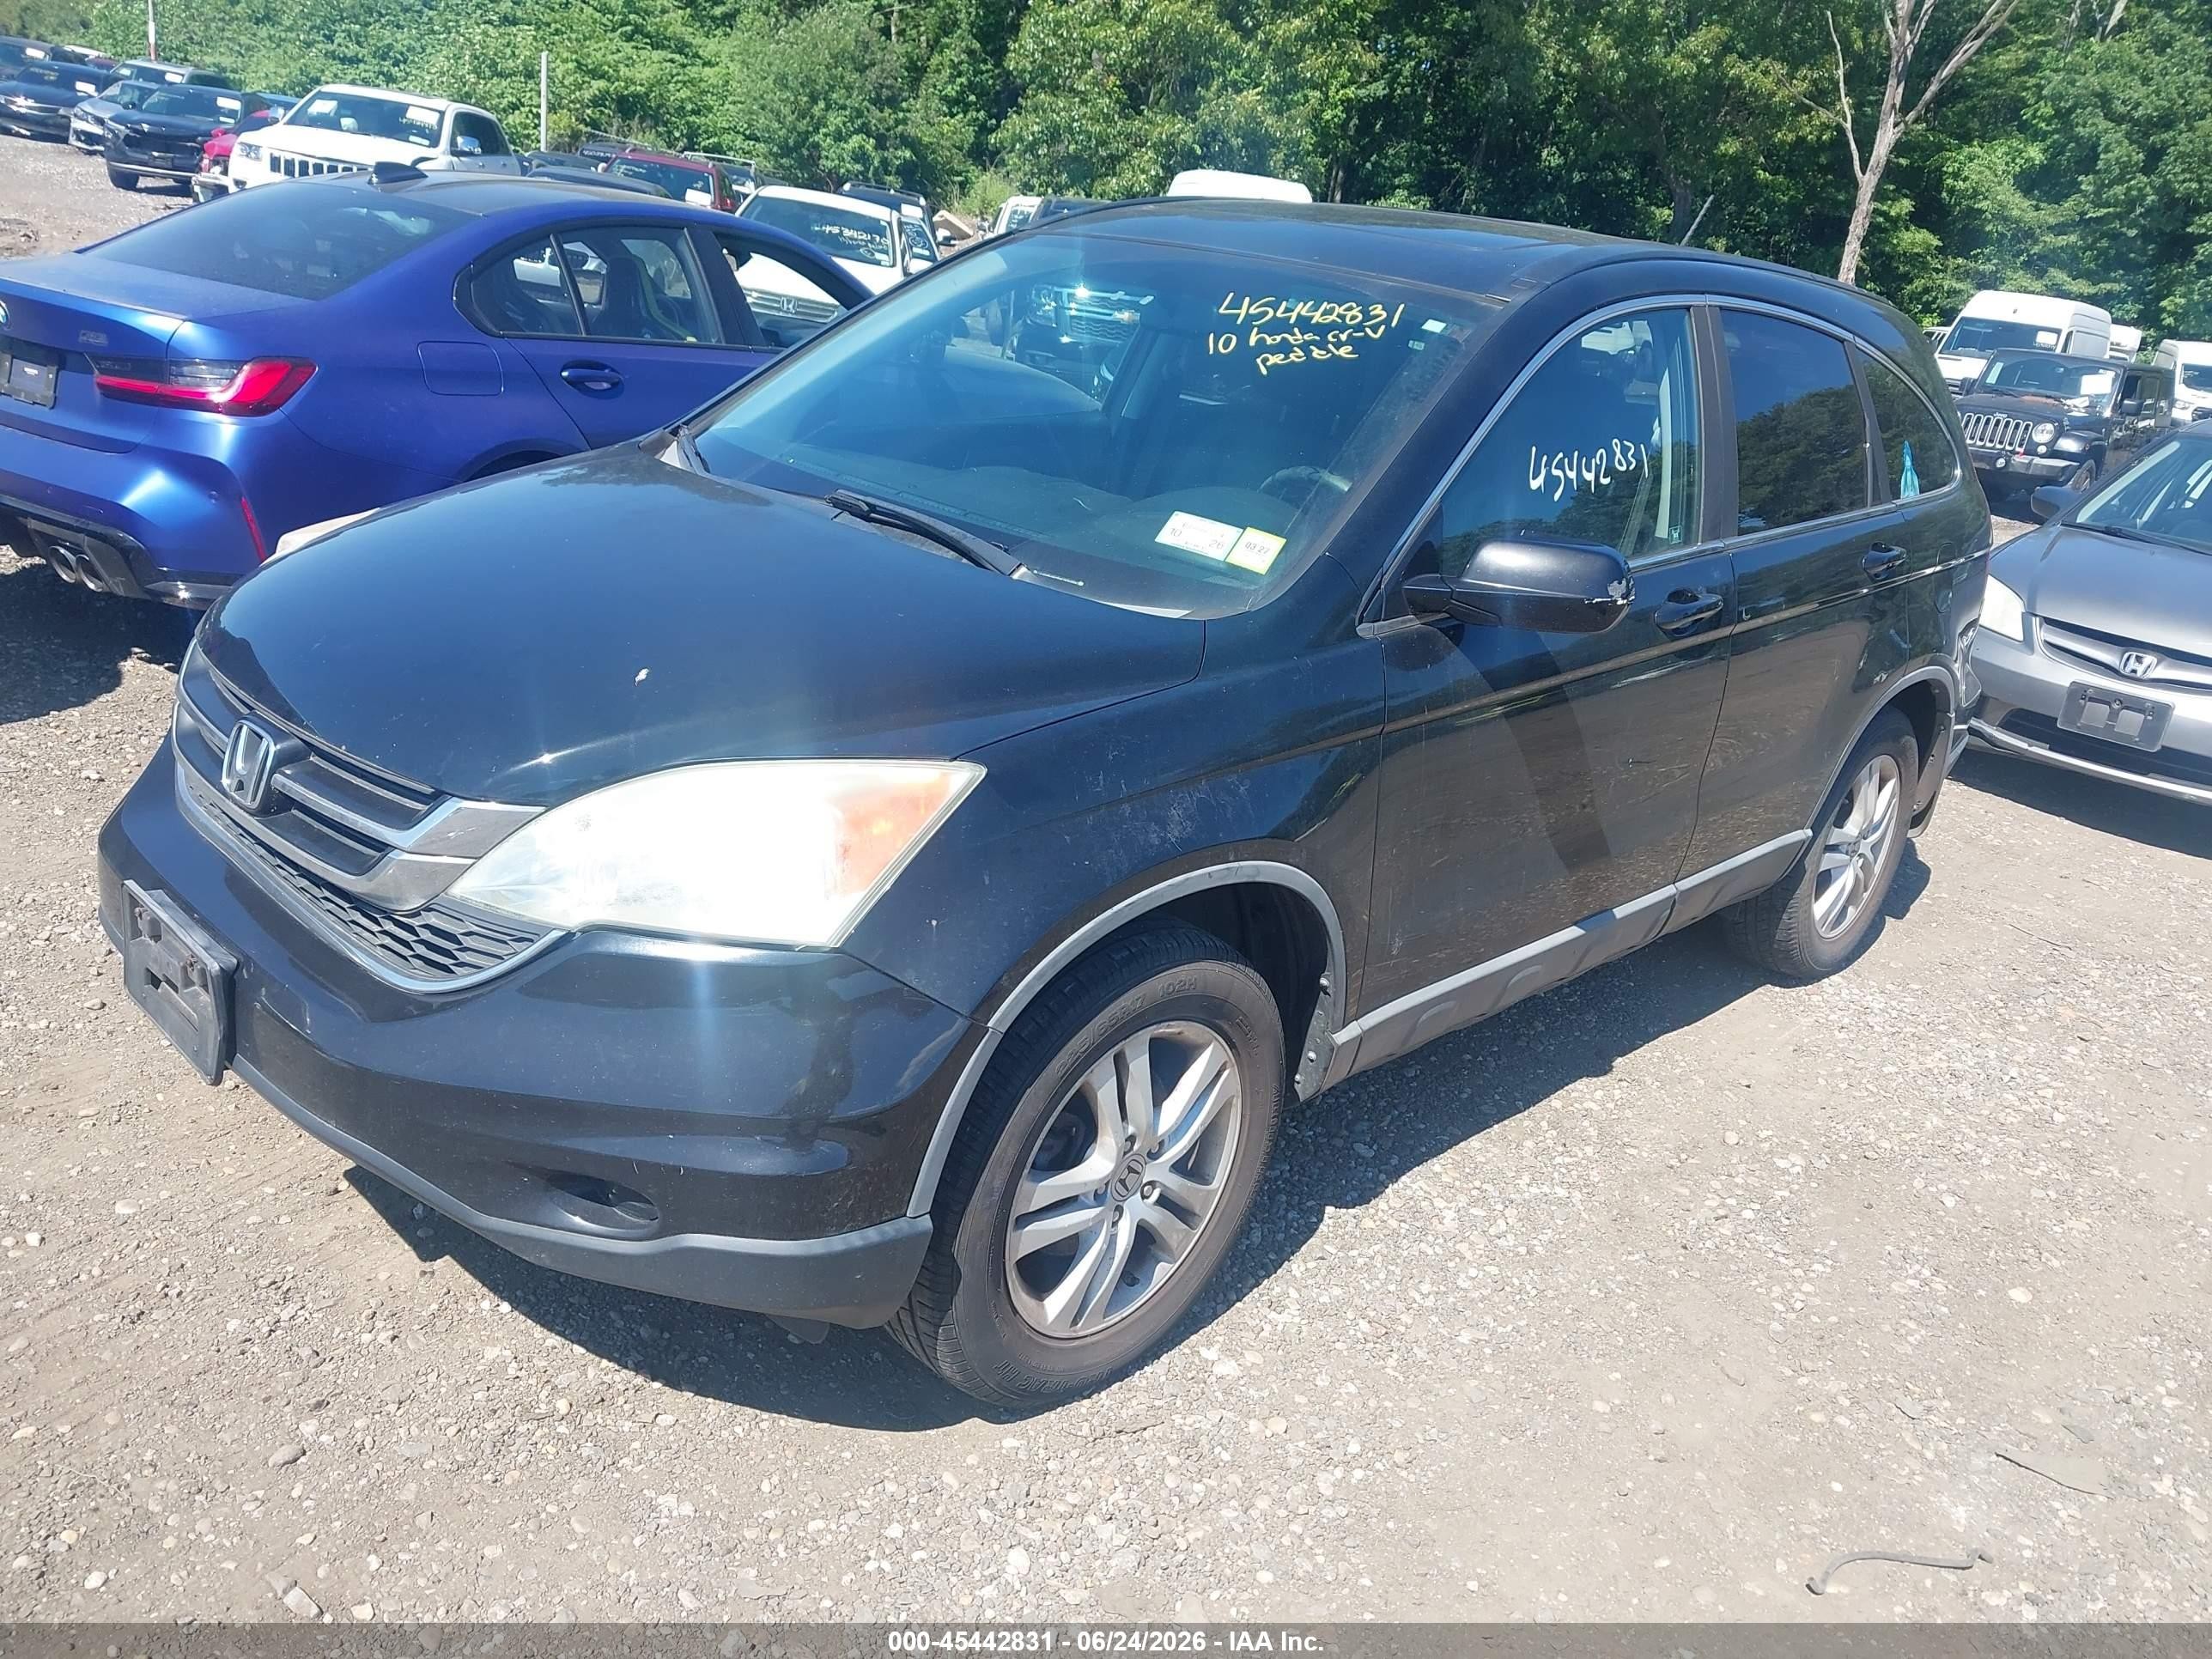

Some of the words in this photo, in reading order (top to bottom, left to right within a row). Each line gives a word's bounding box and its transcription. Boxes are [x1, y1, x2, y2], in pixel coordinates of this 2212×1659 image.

[1218, 292, 1405, 327] 45442831
[1208, 332, 1237, 355] 10
[1249, 326, 1320, 346] honda
[1528, 438, 1649, 502] 45442831
